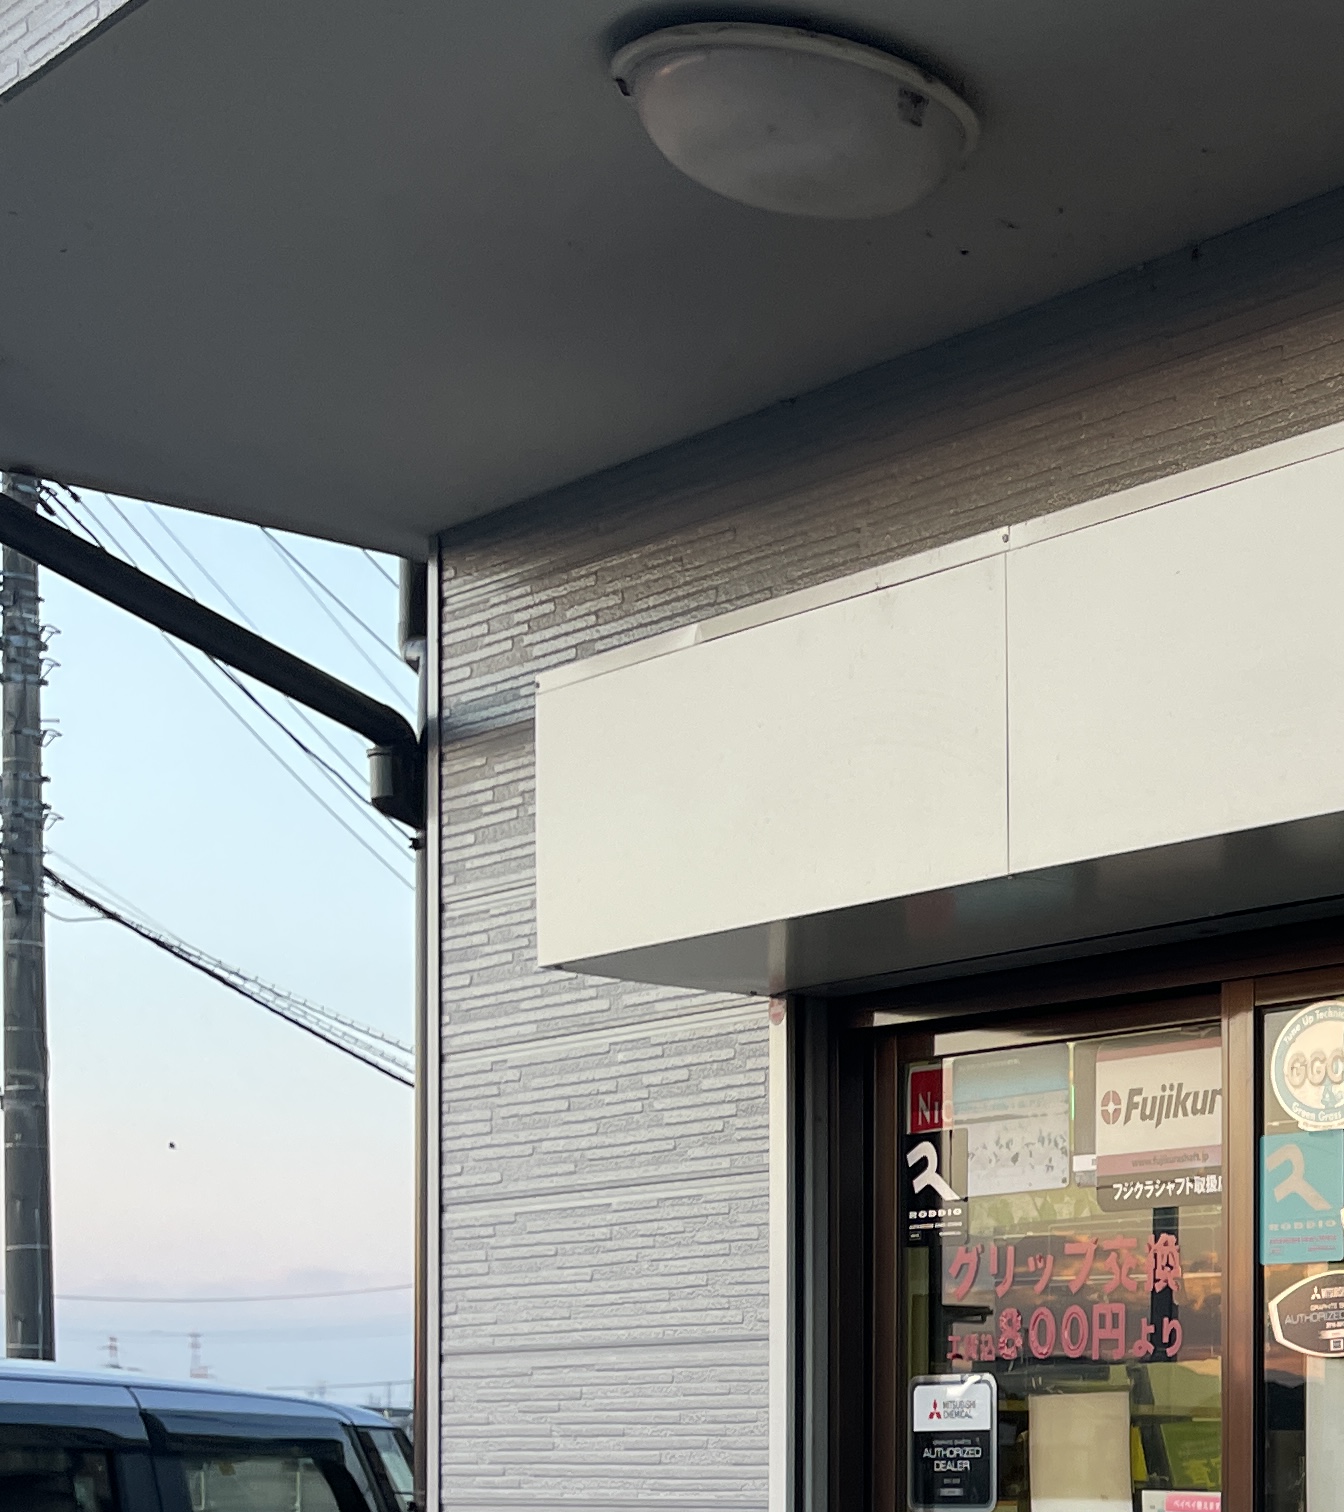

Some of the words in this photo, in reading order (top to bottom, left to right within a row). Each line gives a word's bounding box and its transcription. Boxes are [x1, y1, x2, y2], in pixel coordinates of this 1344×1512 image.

[1301, 1014, 1315, 1027] Up
[1291, 1101, 1316, 1121] Green
[923, 1446, 982, 1459] AUTHORIZED
[934, 1460, 970, 1473] DEALER
